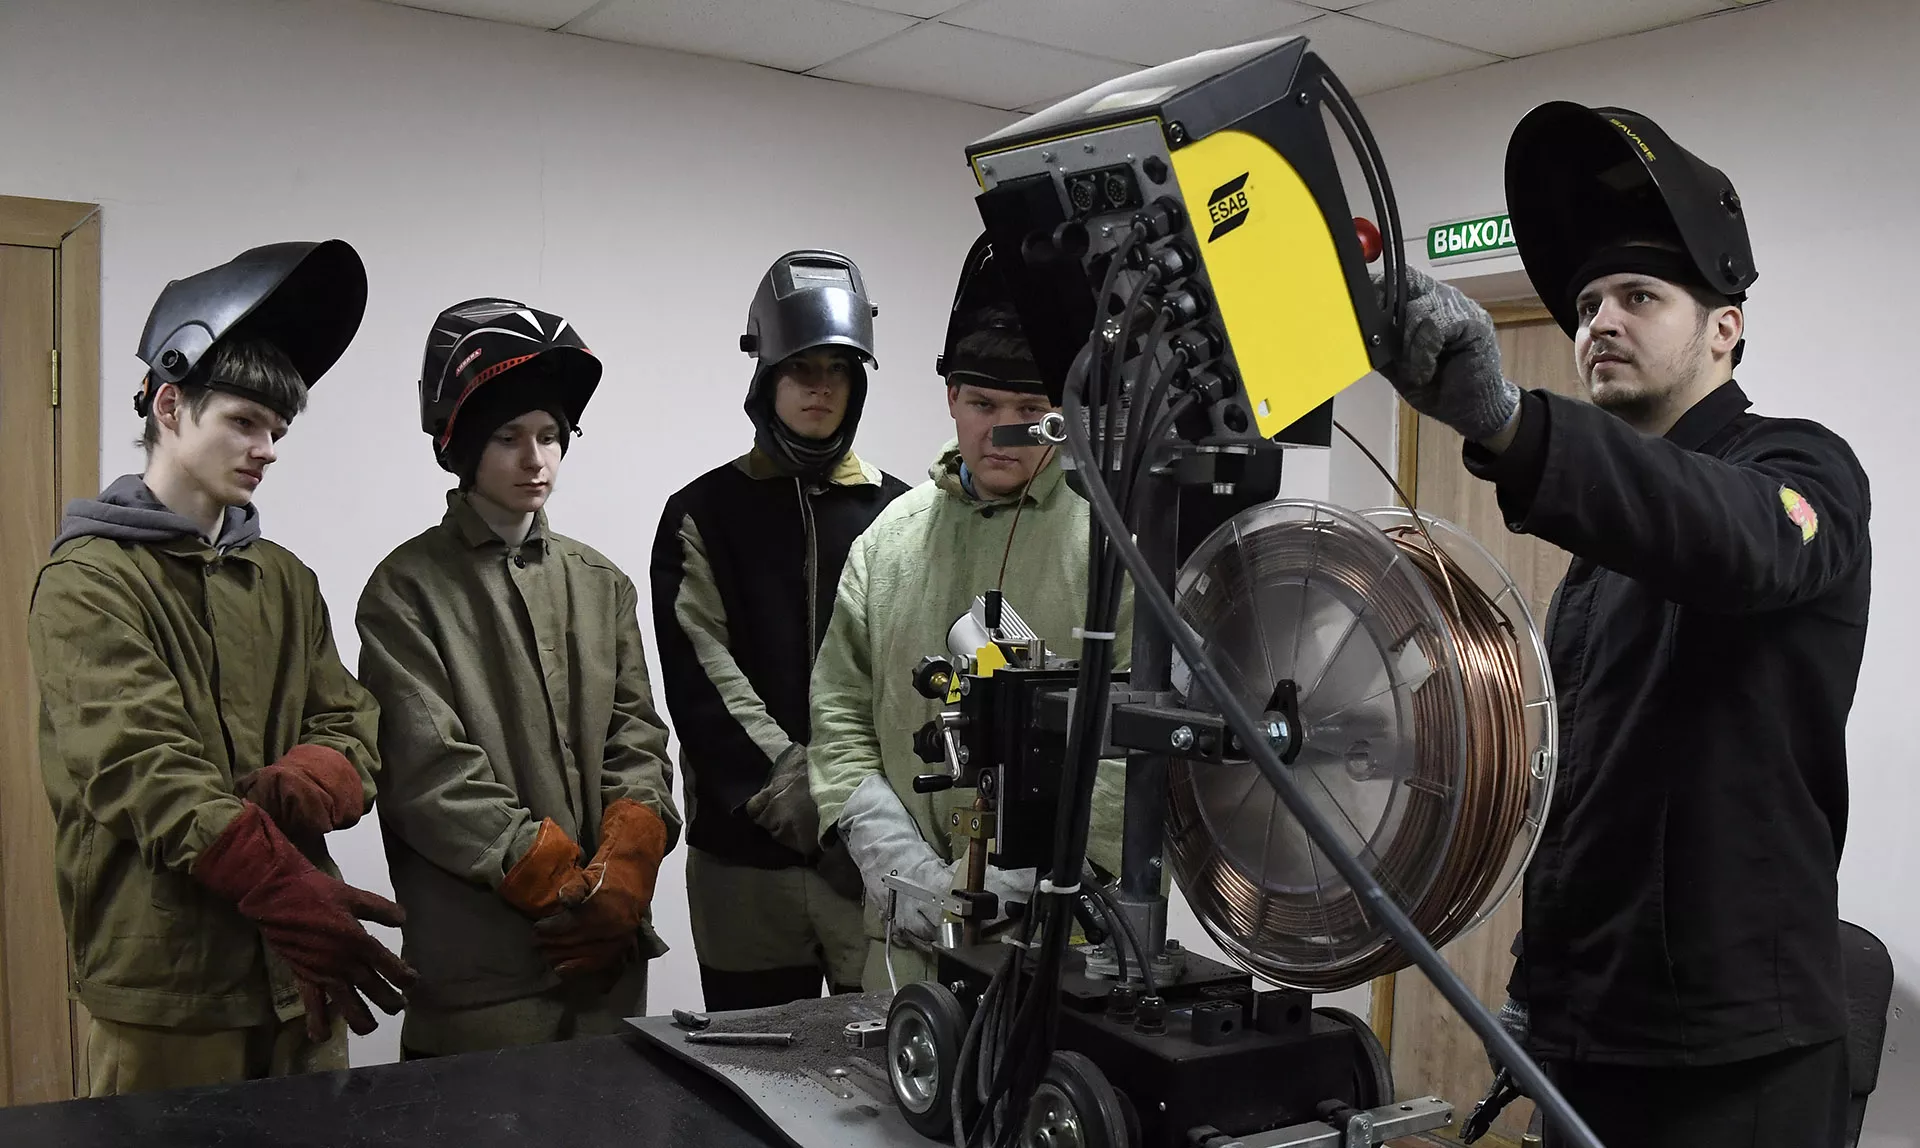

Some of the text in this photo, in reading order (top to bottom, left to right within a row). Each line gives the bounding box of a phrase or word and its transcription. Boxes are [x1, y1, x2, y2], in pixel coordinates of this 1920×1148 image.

[1609, 119, 1656, 162] SAVAGE
[1209, 191, 1248, 224] ESAB
[1434, 218, 1516, 254] ВЫХОД
